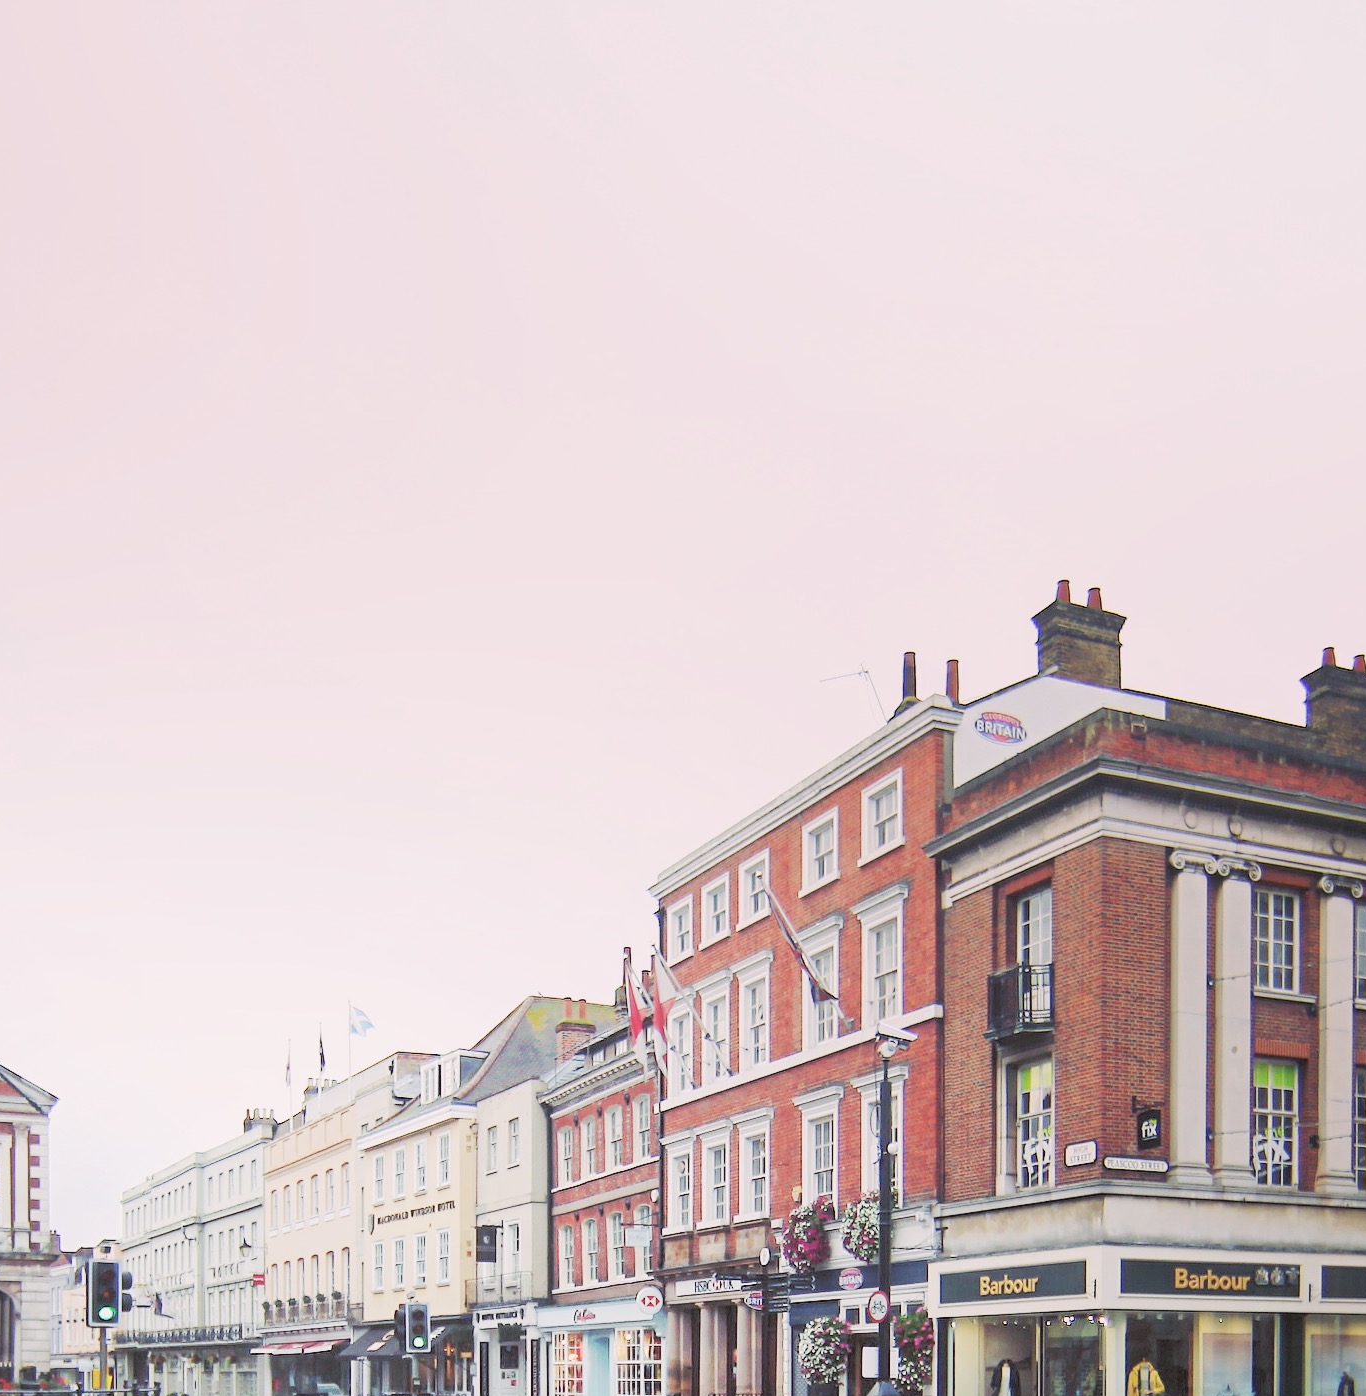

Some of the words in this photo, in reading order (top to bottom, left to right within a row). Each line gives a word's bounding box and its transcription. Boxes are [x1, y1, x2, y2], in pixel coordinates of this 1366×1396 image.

[976, 720, 1026, 740] BRITAIN
[1070, 1154, 1092, 1163] STREET
[1107, 1159, 1138, 1169] PEASCOD
[1141, 1161, 1165, 1171] STREET
[695, 1280, 712, 1292] HSBC
[979, 1276, 1039, 1296] Barbour
[1174, 1268, 1250, 1291] Barbour
